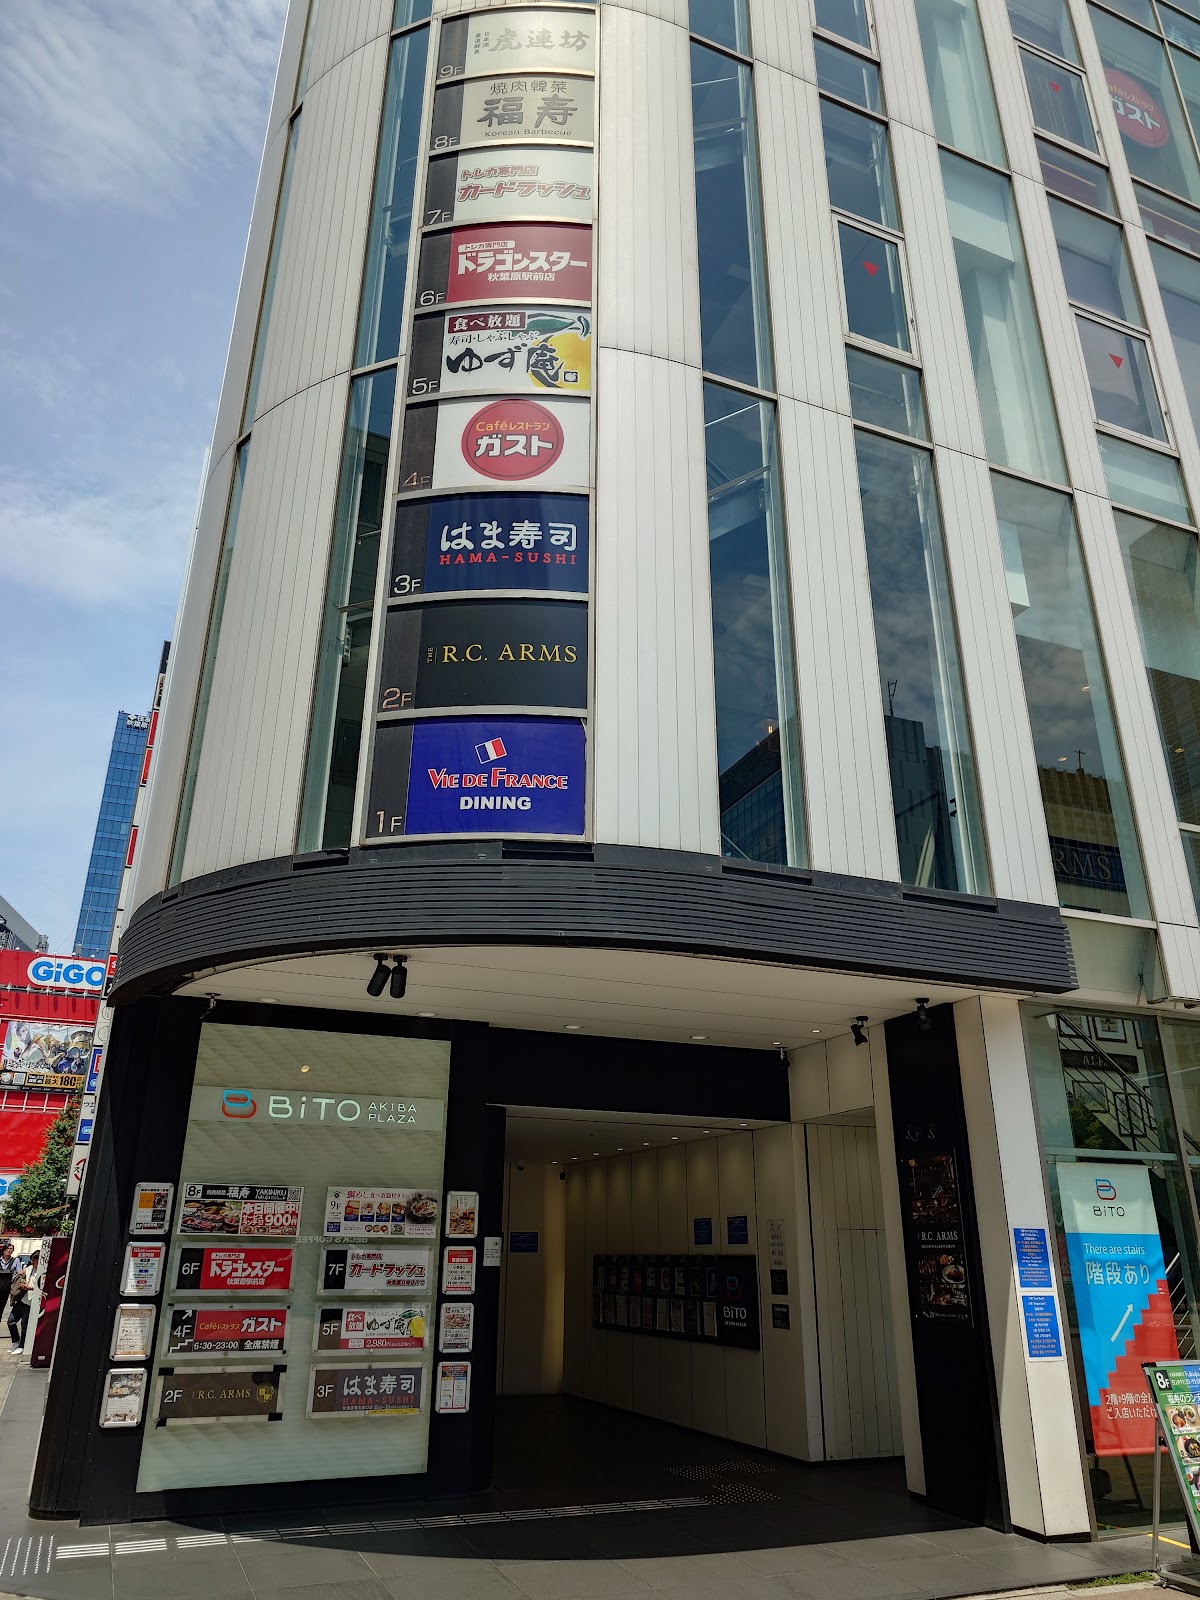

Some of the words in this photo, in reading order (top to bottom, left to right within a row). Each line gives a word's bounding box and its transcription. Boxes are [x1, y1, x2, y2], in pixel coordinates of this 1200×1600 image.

[440, 64, 463, 78] 9F
[489, 80, 568, 95] 焼肉韓菜
[477, 94, 578, 129] 福寿
[485, 129, 520, 137] Korean
[524, 128, 572, 136] Barbecue
[434, 135, 458, 149] 8F
[461, 165, 540, 180] トレカ専門店
[457, 181, 591, 202] カードラッシュ
[427, 209, 451, 225] 7F
[464, 241, 509, 251] トレカ専門店
[457, 250, 588, 275] ドラゴンスター
[488, 272, 556, 282] 秋葉原駅前店
[420, 290, 445, 306] 6F
[453, 314, 522, 332] 食べ放題
[446, 341, 565, 389] ゆず庵
[412, 377, 438, 395] 5F
[474, 433, 553, 458] ガスト
[402, 472, 430, 489] 4F
[440, 520, 577, 551] はま寿司
[439, 552, 577, 565] HAMA-SUSHI
[394, 574, 422, 595] 3F
[442, 644, 489, 663] R.C.
[498, 643, 577, 663] ARMS
[382, 687, 413, 709] 2F
[462, 774, 488, 788] DE
[490, 767, 568, 790] FRANCE
[459, 796, 532, 810] DINING
[376, 810, 403, 834] 1F
[32, 960, 106, 987] GiGO
[268, 1095, 361, 1121] BiTO
[368, 1101, 417, 1113] AKIBA
[368, 1113, 416, 1124] PLAZA
[187, 1186, 201, 1197] 8F
[226, 1187, 250, 1199] 福寿
[330, 1200, 342, 1210] 9F
[1093, 1206, 1125, 1217] BiTO
[936, 1230, 958, 1241] ARMS
[1083, 1243, 1107, 1254] There
[1109, 1246, 1122, 1254] are
[1123, 1244, 1147, 1255] stairs.
[182, 1262, 200, 1275] 6F
[210, 1260, 284, 1277] ドラゴンスター
[328, 1264, 344, 1276] 7F
[349, 1262, 425, 1277] カードラッシュ
[1085, 1261, 1150, 1285] 階段あり
[723, 1306, 747, 1320] BiTO
[173, 1325, 192, 1338] 4F
[241, 1316, 282, 1333] ガスト
[322, 1323, 339, 1335] 5F
[244, 1339, 280, 1350] 全席禁煙
[343, 1373, 415, 1396] はま寿司
[1156, 1372, 1170, 1389] 8F
[164, 1389, 184, 1403] 2F
[198, 1390, 216, 1399] R.C.
[221, 1389, 251, 1399] ARMS
[317, 1385, 334, 1398] 3F
